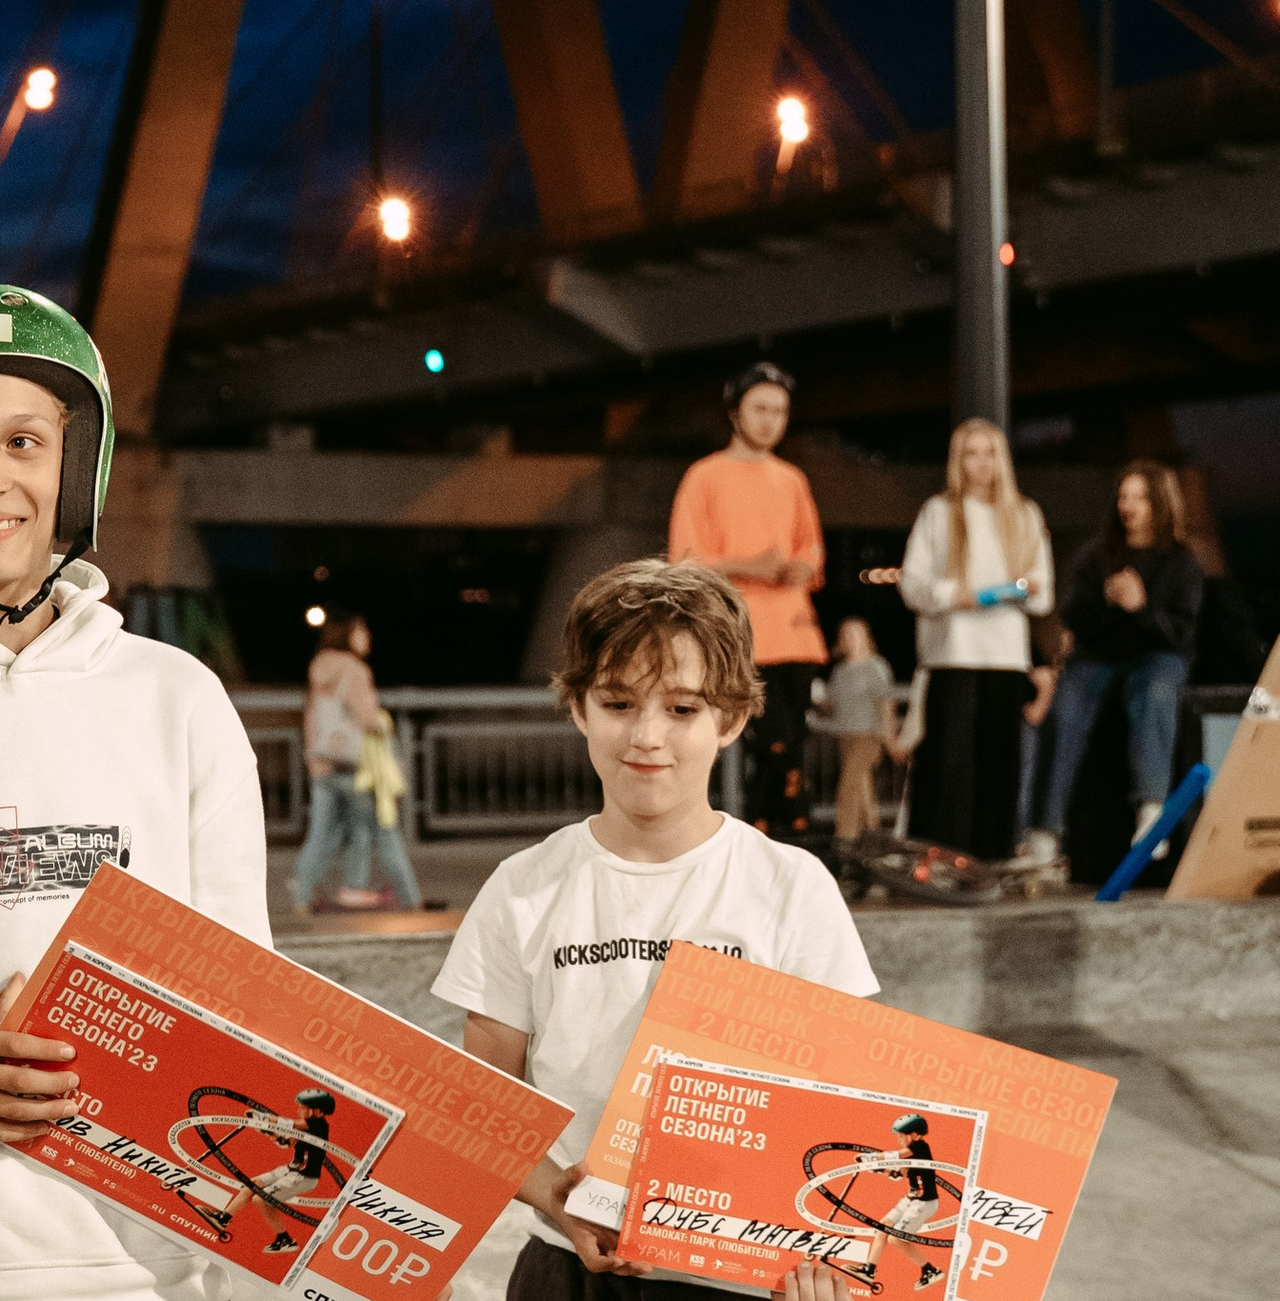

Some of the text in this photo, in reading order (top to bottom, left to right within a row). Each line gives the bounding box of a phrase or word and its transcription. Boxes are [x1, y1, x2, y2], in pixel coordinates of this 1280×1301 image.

[0, 896, 26, 905] oncept
[36, 893, 70, 902] memories
[553, 937, 673, 969] KICKSCOOTERS
[55, 985, 146, 1043] ЛЕТНЕГО
[66, 966, 177, 1035] ОТКРЫТИЕ
[45, 1004, 160, 1074] СЕЗОНА'23
[163, 939, 255, 1005] ПАРК
[300, 1013, 464, 1117] ОТКРЫТИЕ
[458, 1097, 554, 1165] СЕЗО
[244, 946, 368, 1029] СЕЗОНА
[424, 1043, 547, 1124] КАЗАНЬ
[695, 1011, 714, 1037] 2
[719, 1018, 817, 1069] МЕСТО
[739, 995, 814, 1039] ПАРК
[866, 1036, 1016, 1103] ОТКРЫТИЕ
[1018, 1084, 1107, 1133] СЕЗО
[61, 1084, 104, 1118] СТО
[663, 1094, 747, 1125] ЛЕТНЕГО
[668, 1074, 771, 1108] ОТКРЫТИЕ
[40, 1144, 59, 1159] KSS
[659, 1115, 767, 1151] СЕЗОНА'23
[46, 1126, 74, 1147] ПАРК
[73, 1140, 138, 1180] (ЛЮБИТЕЛИ)
[488, 1149, 532, 1189] ПА
[646, 1178, 732, 1211] 2 МЕСТО
[169, 1213, 219, 1243] СПУТНИК
[638, 1224, 780, 1261] САМОКАТ: ПАРК (ЛЮБИТЕЛИ)
